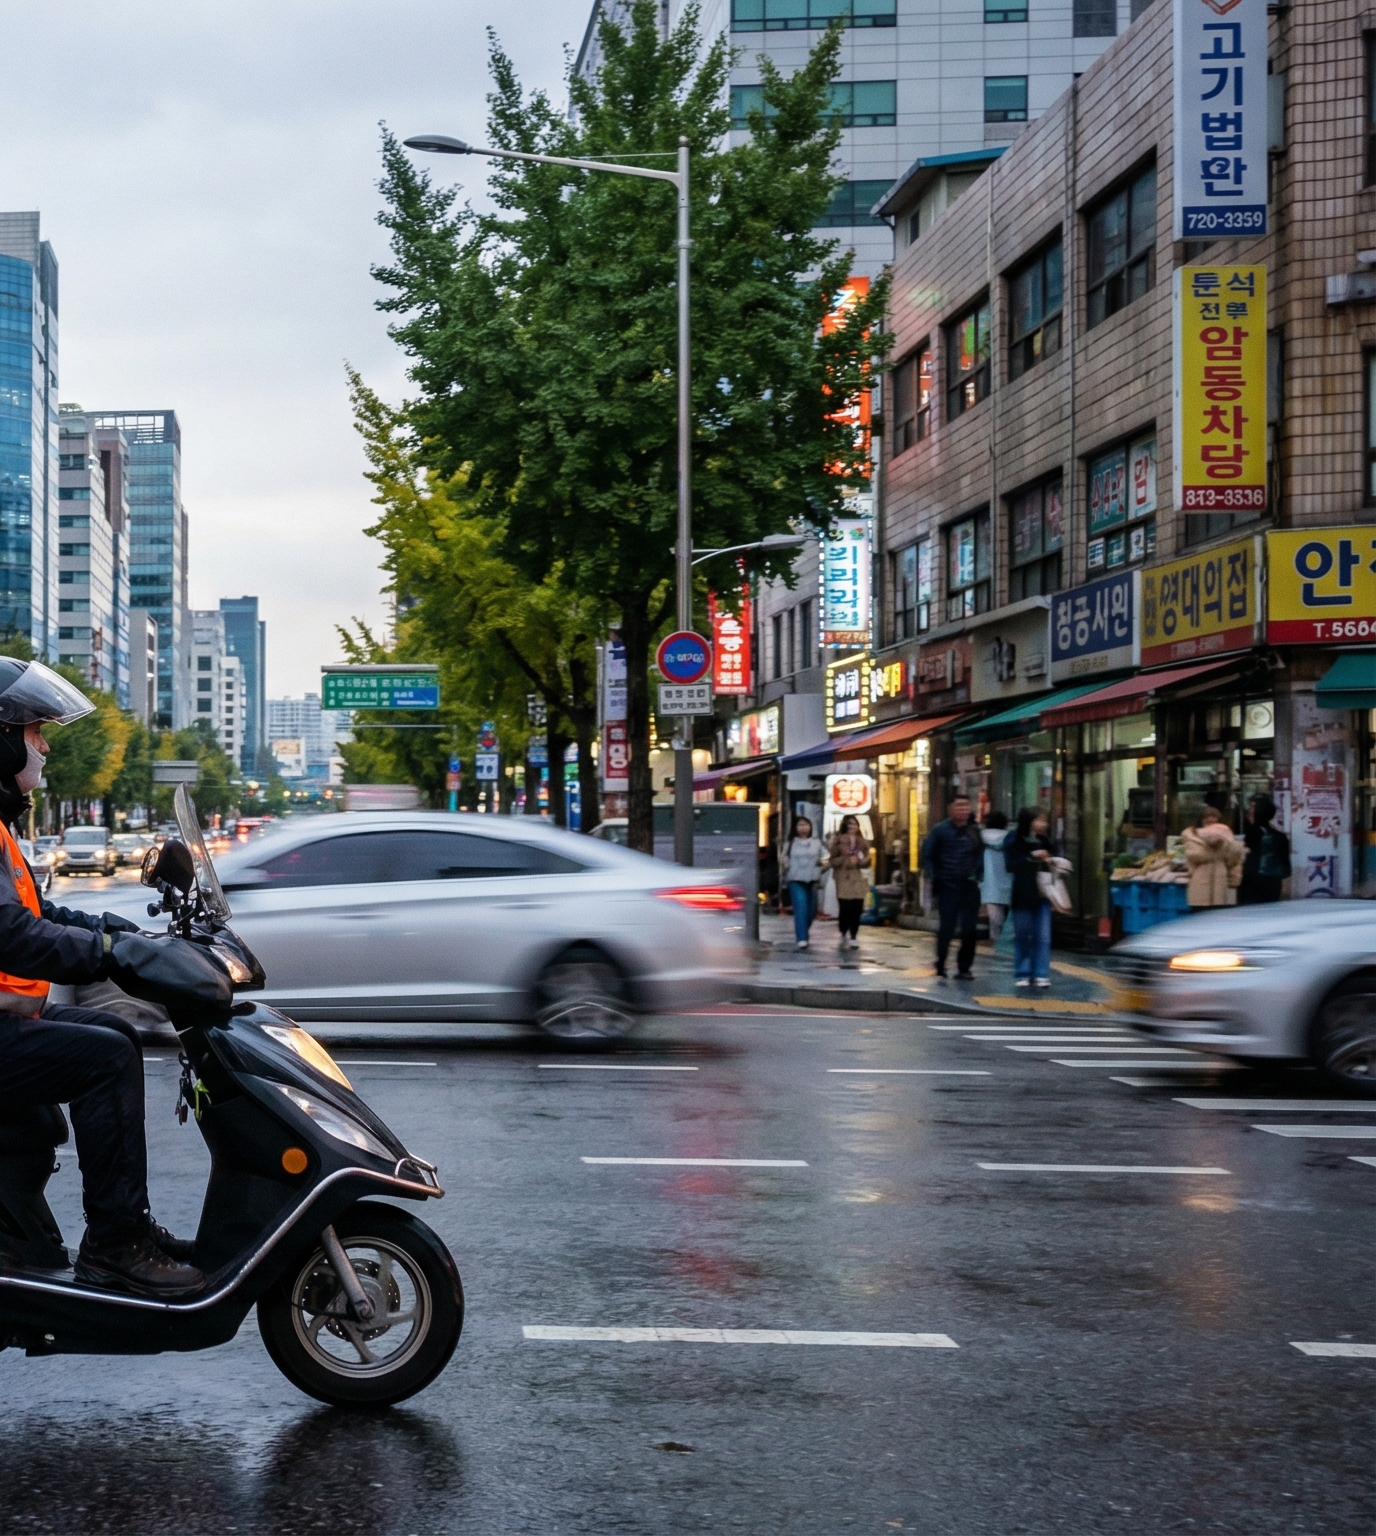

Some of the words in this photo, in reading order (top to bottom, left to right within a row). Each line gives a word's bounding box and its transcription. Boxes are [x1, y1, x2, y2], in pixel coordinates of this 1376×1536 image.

[1187, 211, 1264, 229] 720-3359
[1199, 326, 1250, 480] 암동차당
[1293, 540, 1376, 607] 안
